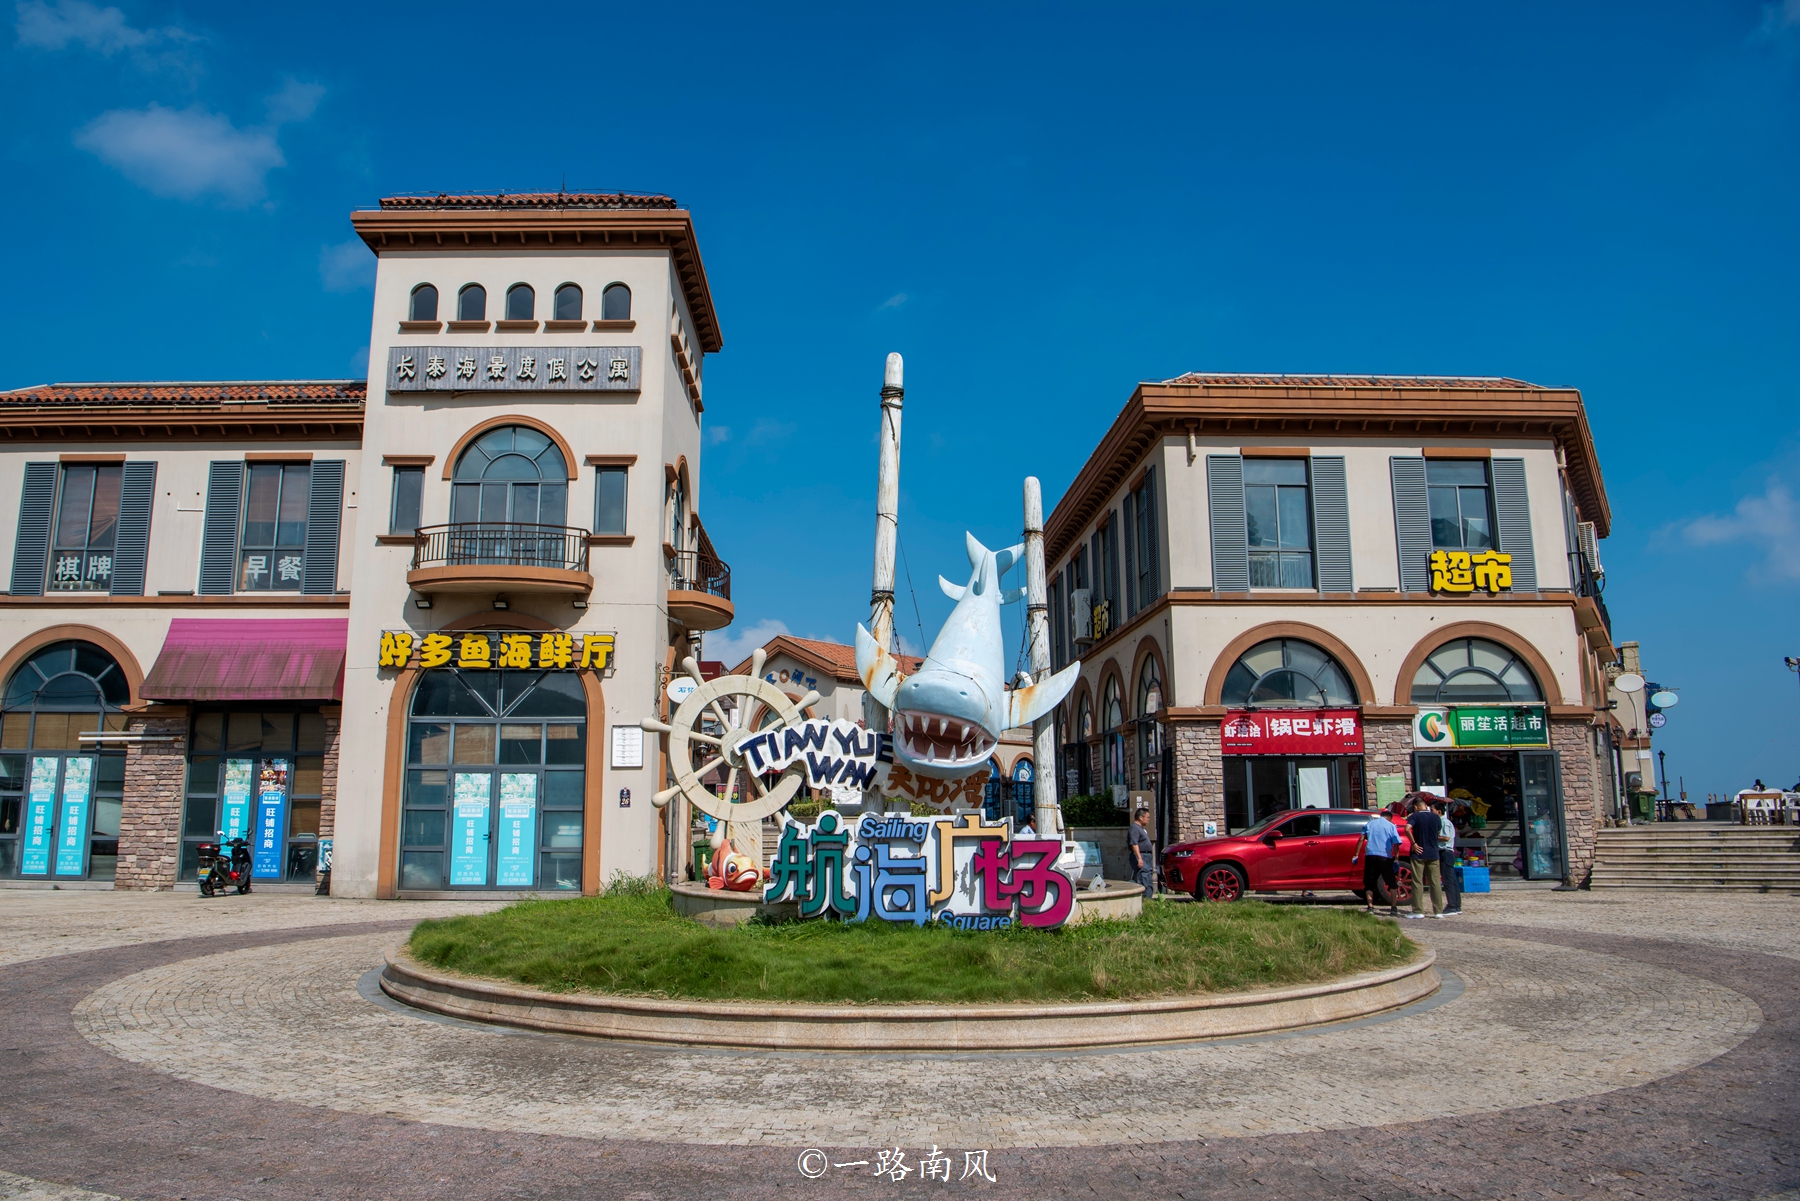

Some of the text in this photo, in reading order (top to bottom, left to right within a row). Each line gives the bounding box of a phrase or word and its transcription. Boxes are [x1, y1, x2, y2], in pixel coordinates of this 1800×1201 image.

[396, 355, 629, 380] 长泰海景度假公寓
[55, 555, 112, 581] 棋牌
[244, 555, 302, 582] 早餐
[1430, 549, 1512, 593] 超市
[379, 631, 616, 670] 好多鱼海鲜厅
[1270, 717, 1356, 737] 锅巴虾滑
[1459, 715, 1542, 731] 丽笙活超市
[738, 723, 893, 771] TIAN YUE
[807, 751, 878, 790] WAN
[228, 807, 241, 839] 旺铺招
[263, 807, 276, 849] 旺铺招商
[860, 818, 929, 843] Sailing
[766, 813, 1074, 928] 航海广场
[938, 911, 1012, 931] Square
